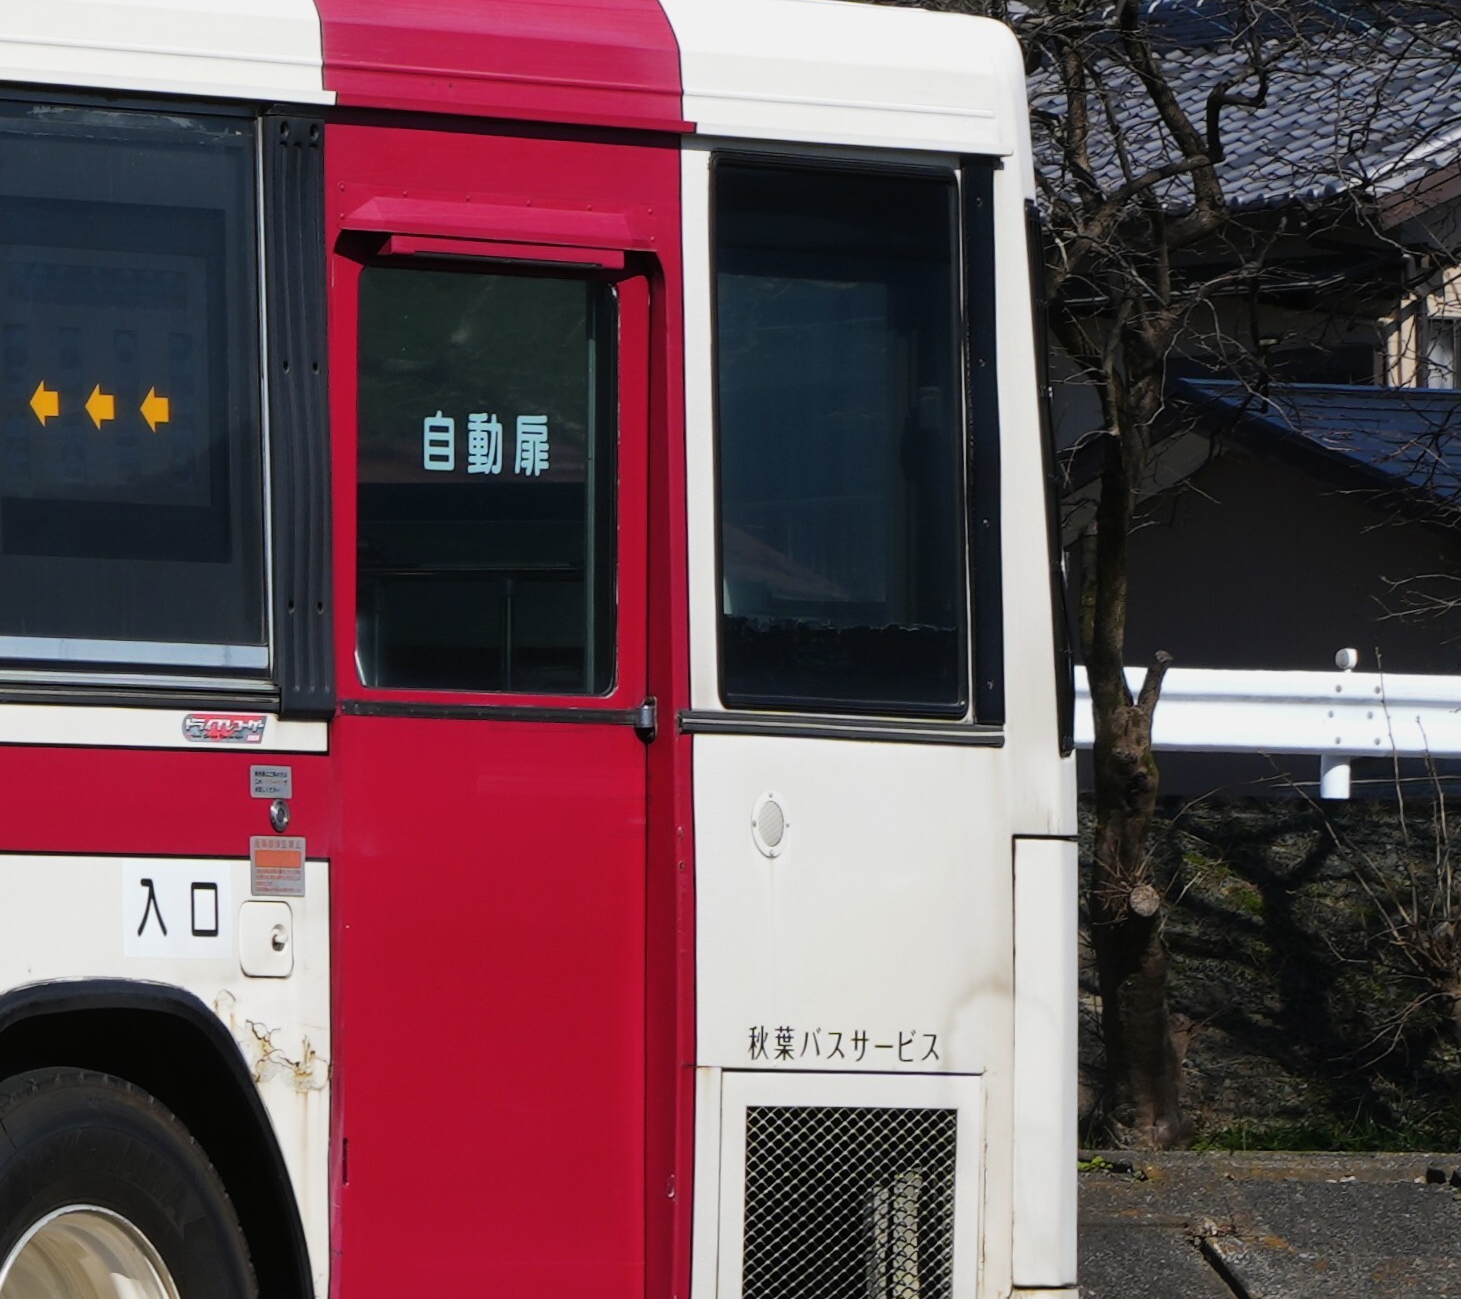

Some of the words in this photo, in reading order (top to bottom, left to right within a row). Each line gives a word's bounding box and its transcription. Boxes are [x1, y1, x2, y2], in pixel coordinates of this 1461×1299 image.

[422, 409, 551, 478] 自動扉
[136, 877, 220, 938] 入口
[747, 1024, 940, 1063] 秋葉バスサービス
